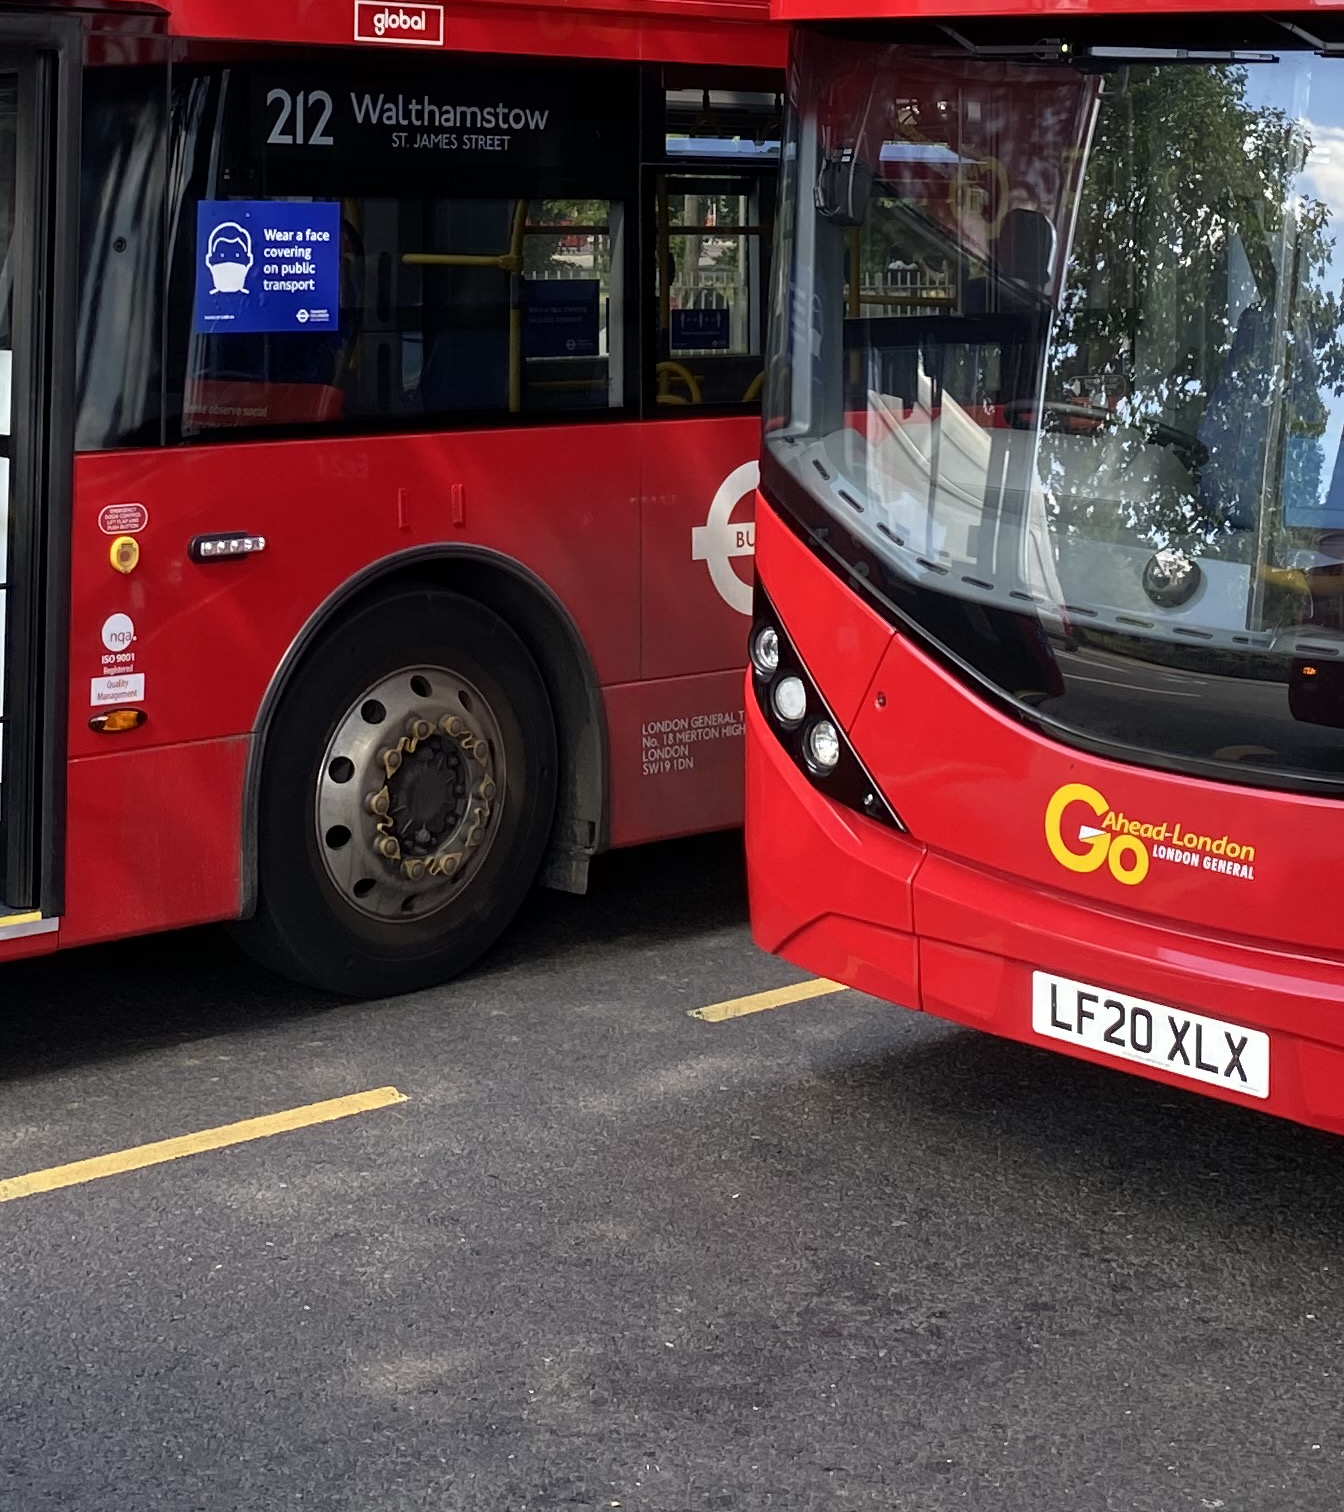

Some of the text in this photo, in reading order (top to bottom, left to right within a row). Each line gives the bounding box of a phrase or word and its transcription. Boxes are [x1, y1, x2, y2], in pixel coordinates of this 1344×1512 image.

[373, 8, 426, 35] global
[266, 88, 549, 145] 212 Walthamstow
[391, 132, 511, 151] ST. JAMES STREET
[263, 228, 330, 241] Wear a face
[263, 246, 312, 260] covering
[263, 262, 316, 276] on public
[263, 279, 316, 293] transport
[101, 653, 135, 664] ISO 9001
[97, 690, 137, 701] Management
[642, 718, 689, 735] LONDON
[690, 712, 736, 728] GENERAL
[642, 735, 659, 748] No.
[663, 733, 674, 745] 18
[676, 726, 721, 743] MERTON
[642, 744, 689, 762] LONDON
[642, 757, 694, 776] SW19 1DN
[1044, 782, 1149, 885] Go
[1101, 810, 1256, 861] Ahead-London
[1153, 844, 1255, 880] LONDON GENERAL
[1050, 982, 1249, 1082] LF20 XLX
